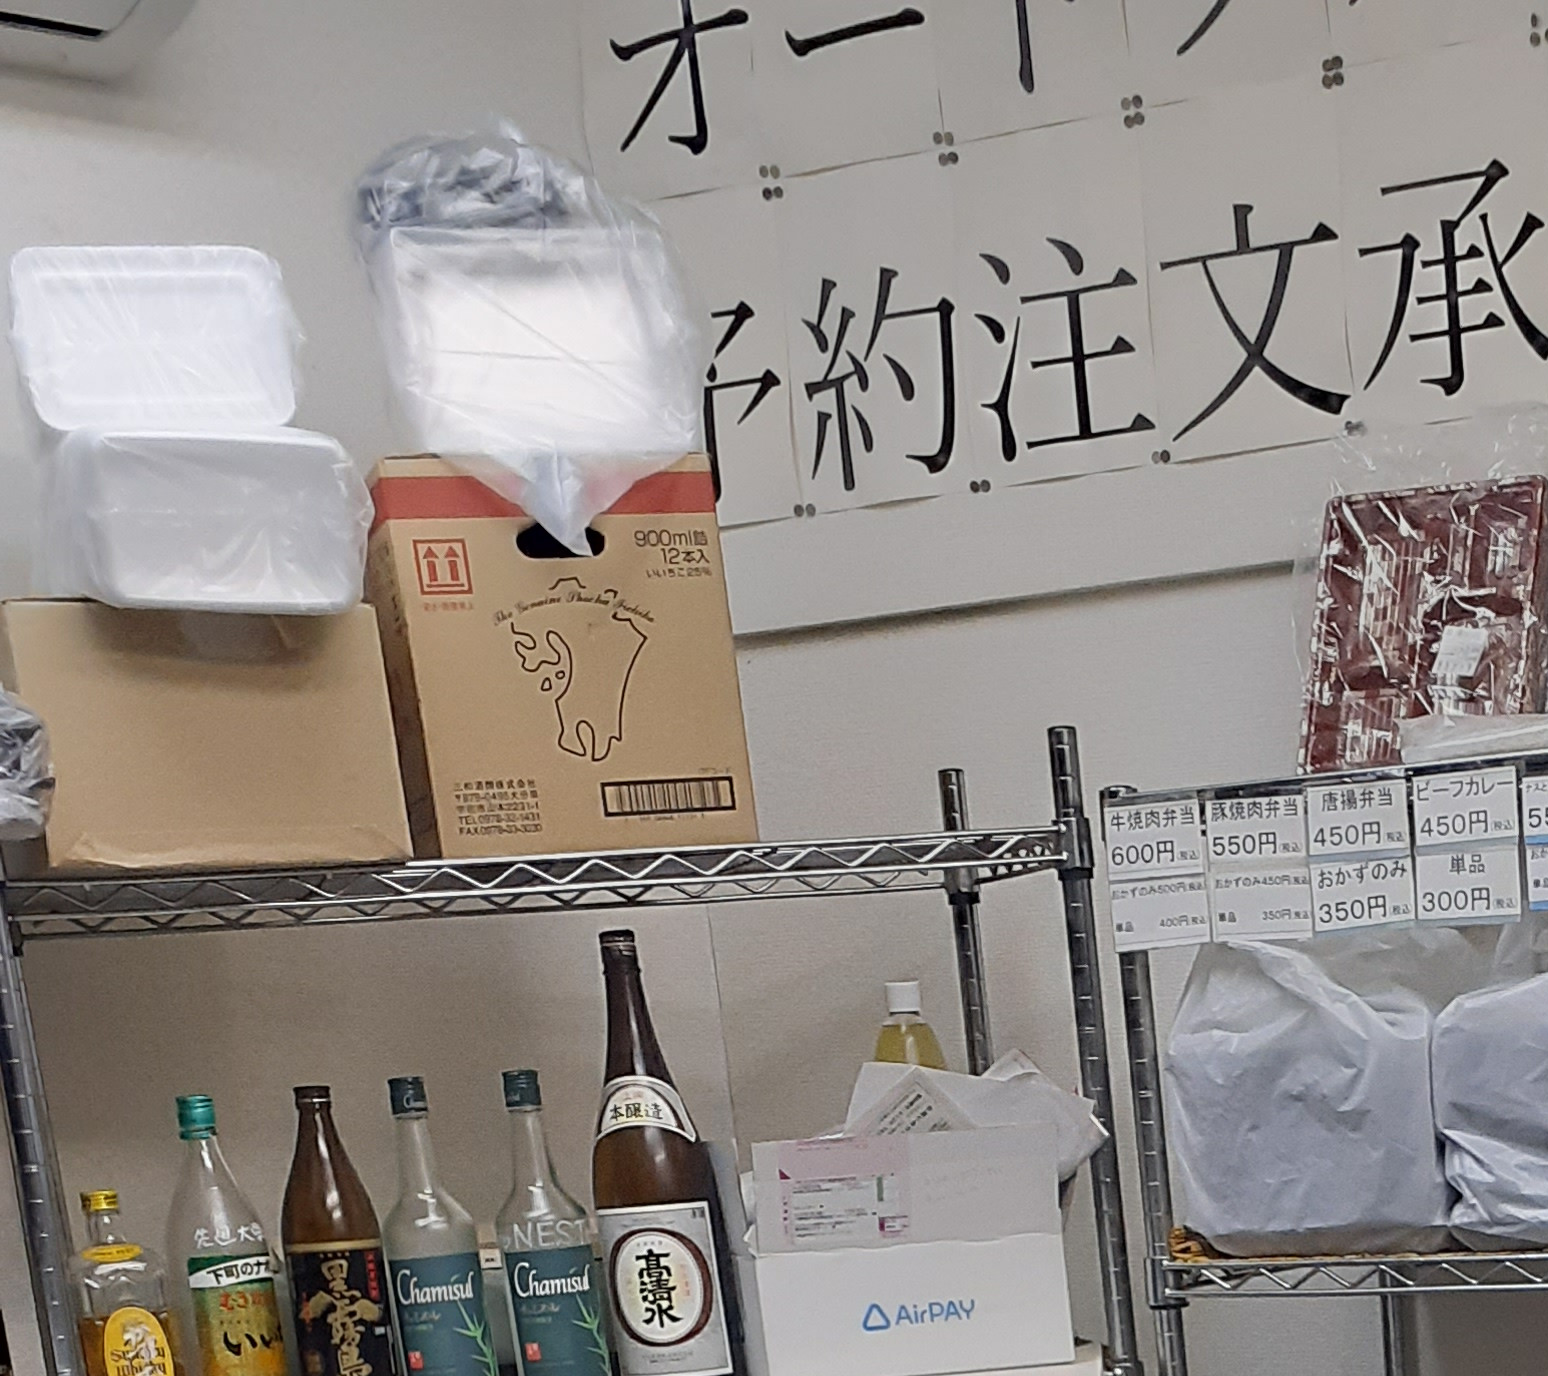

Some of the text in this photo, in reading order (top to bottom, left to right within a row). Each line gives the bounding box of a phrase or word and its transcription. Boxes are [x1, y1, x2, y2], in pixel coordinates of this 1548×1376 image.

[660, 547, 711, 565] 12本入
[1321, 787, 1394, 813] 唐揚弁当
[1416, 777, 1515, 802] ビーフカレー
[1110, 805, 1196, 833] 牛焼肉弁当
[1211, 796, 1299, 823] 豚焼肉弁当
[1317, 860, 1408, 889] おかずのみ
[1449, 853, 1486, 876] 単品
[396, 1268, 475, 1306] Chamisul
[514, 1261, 591, 1299] Chamisul
[895, 1299, 976, 1328] AirPAY
